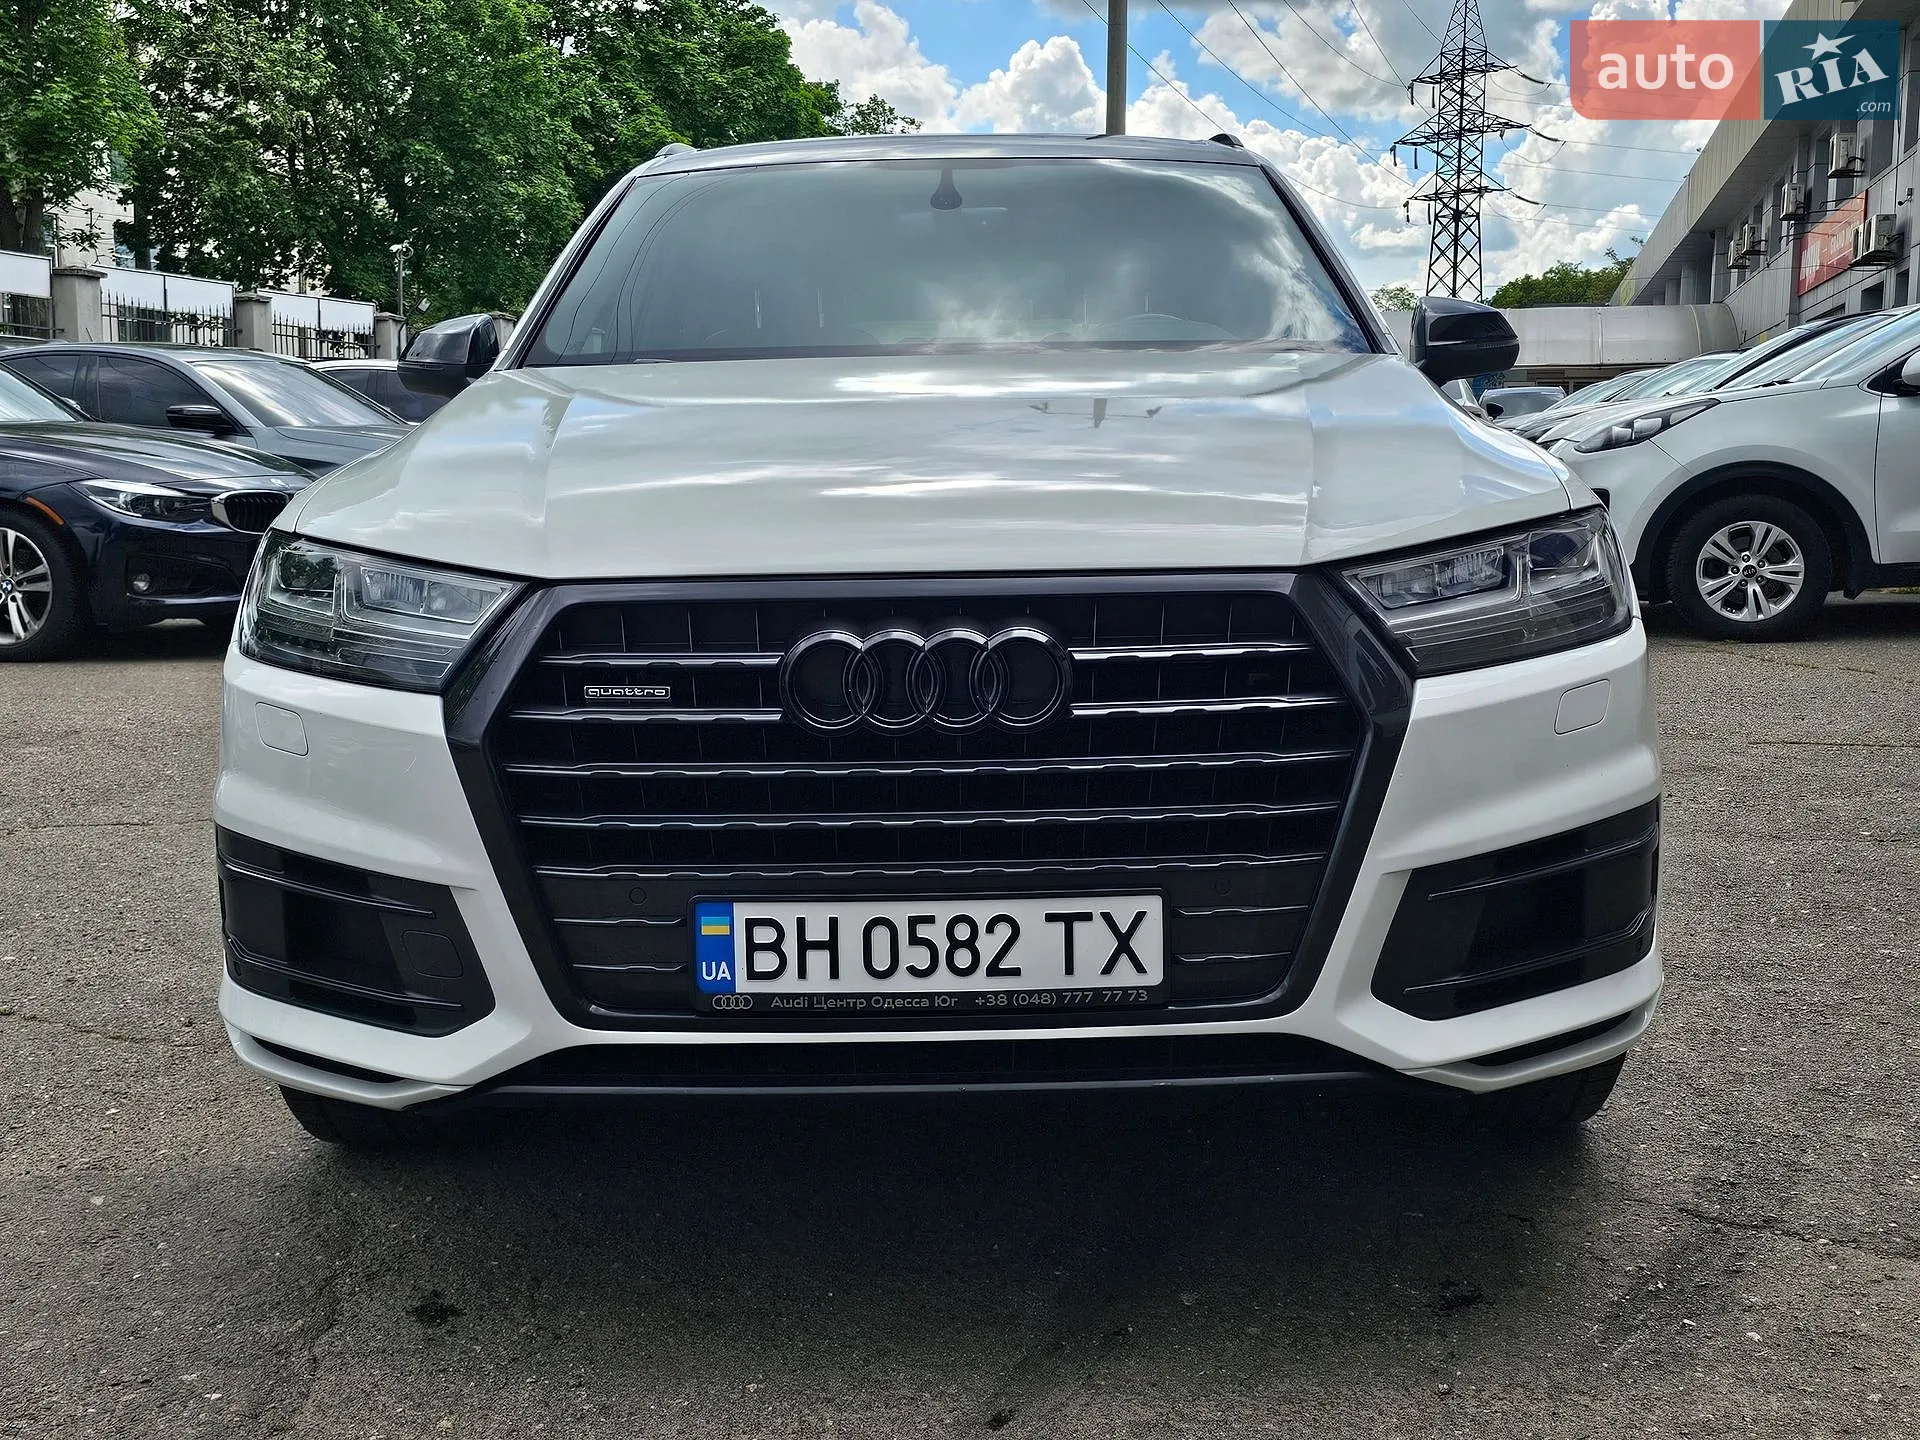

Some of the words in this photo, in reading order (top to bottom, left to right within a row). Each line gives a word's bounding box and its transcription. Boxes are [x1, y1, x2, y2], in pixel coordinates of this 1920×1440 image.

[588, 688, 665, 696] quattro
[744, 915, 840, 981] BH
[862, 913, 1022, 979] 0582
[1044, 910, 1148, 976] TX
[702, 961, 731, 981] UA
[771, 996, 809, 1008] Audi
[814, 996, 866, 1009] Центр
[871, 996, 929, 1009] Одесса
[934, 994, 958, 1008] Юг
[975, 994, 1008, 1006] +38
[1013, 992, 1057, 1006] (048)
[1062, 991, 1093, 1004] 777
[1102, 990, 1122, 1002] 77
[1127, 989, 1148, 1002] 73
